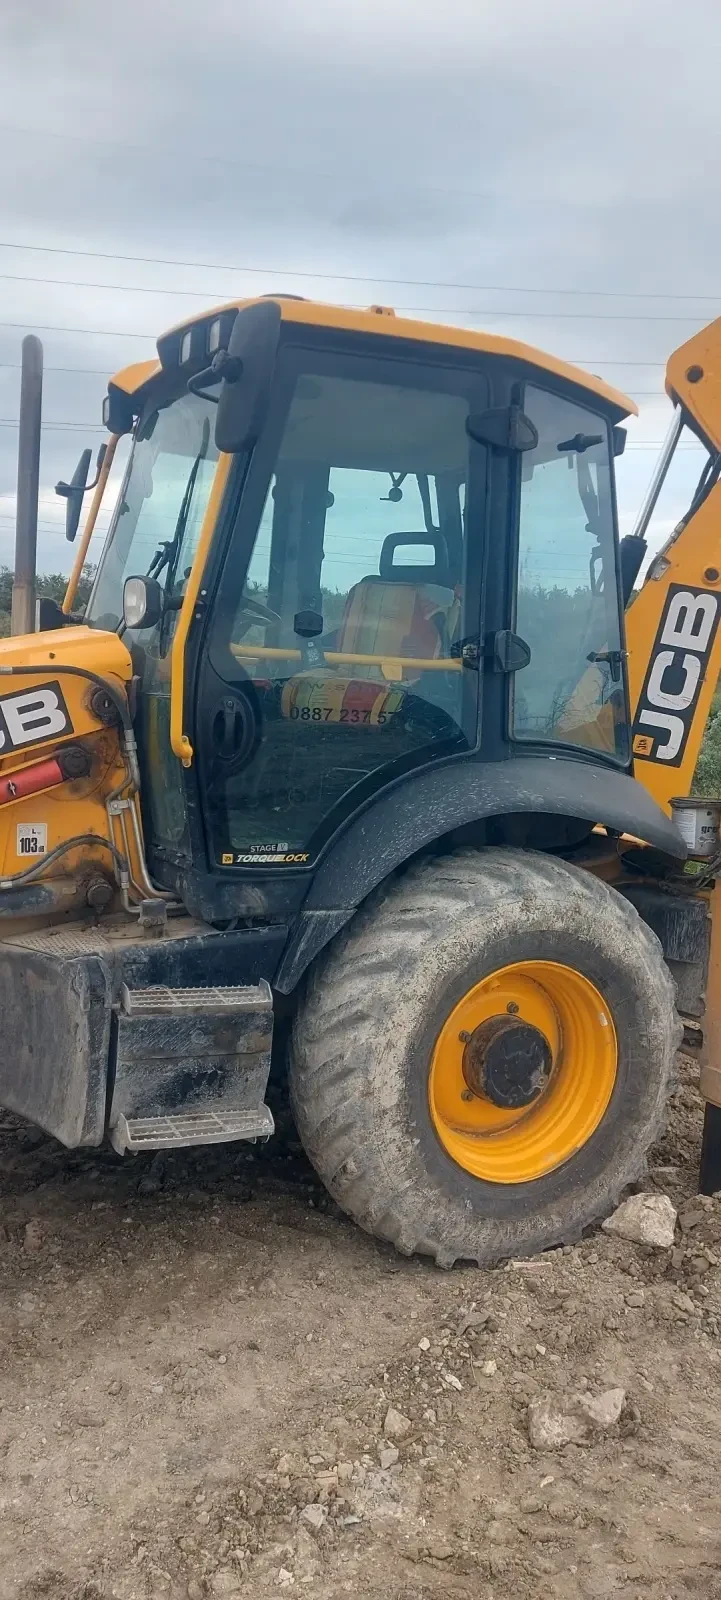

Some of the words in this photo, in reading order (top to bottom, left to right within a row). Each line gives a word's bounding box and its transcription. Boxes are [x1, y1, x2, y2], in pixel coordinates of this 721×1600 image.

[639, 591, 719, 760] JCB
[0, 689, 67, 747] B
[290, 706, 333, 721] 0887
[338, 708, 370, 723] 237
[19, 837, 38, 854] 103
[250, 844, 276, 852] STAGE
